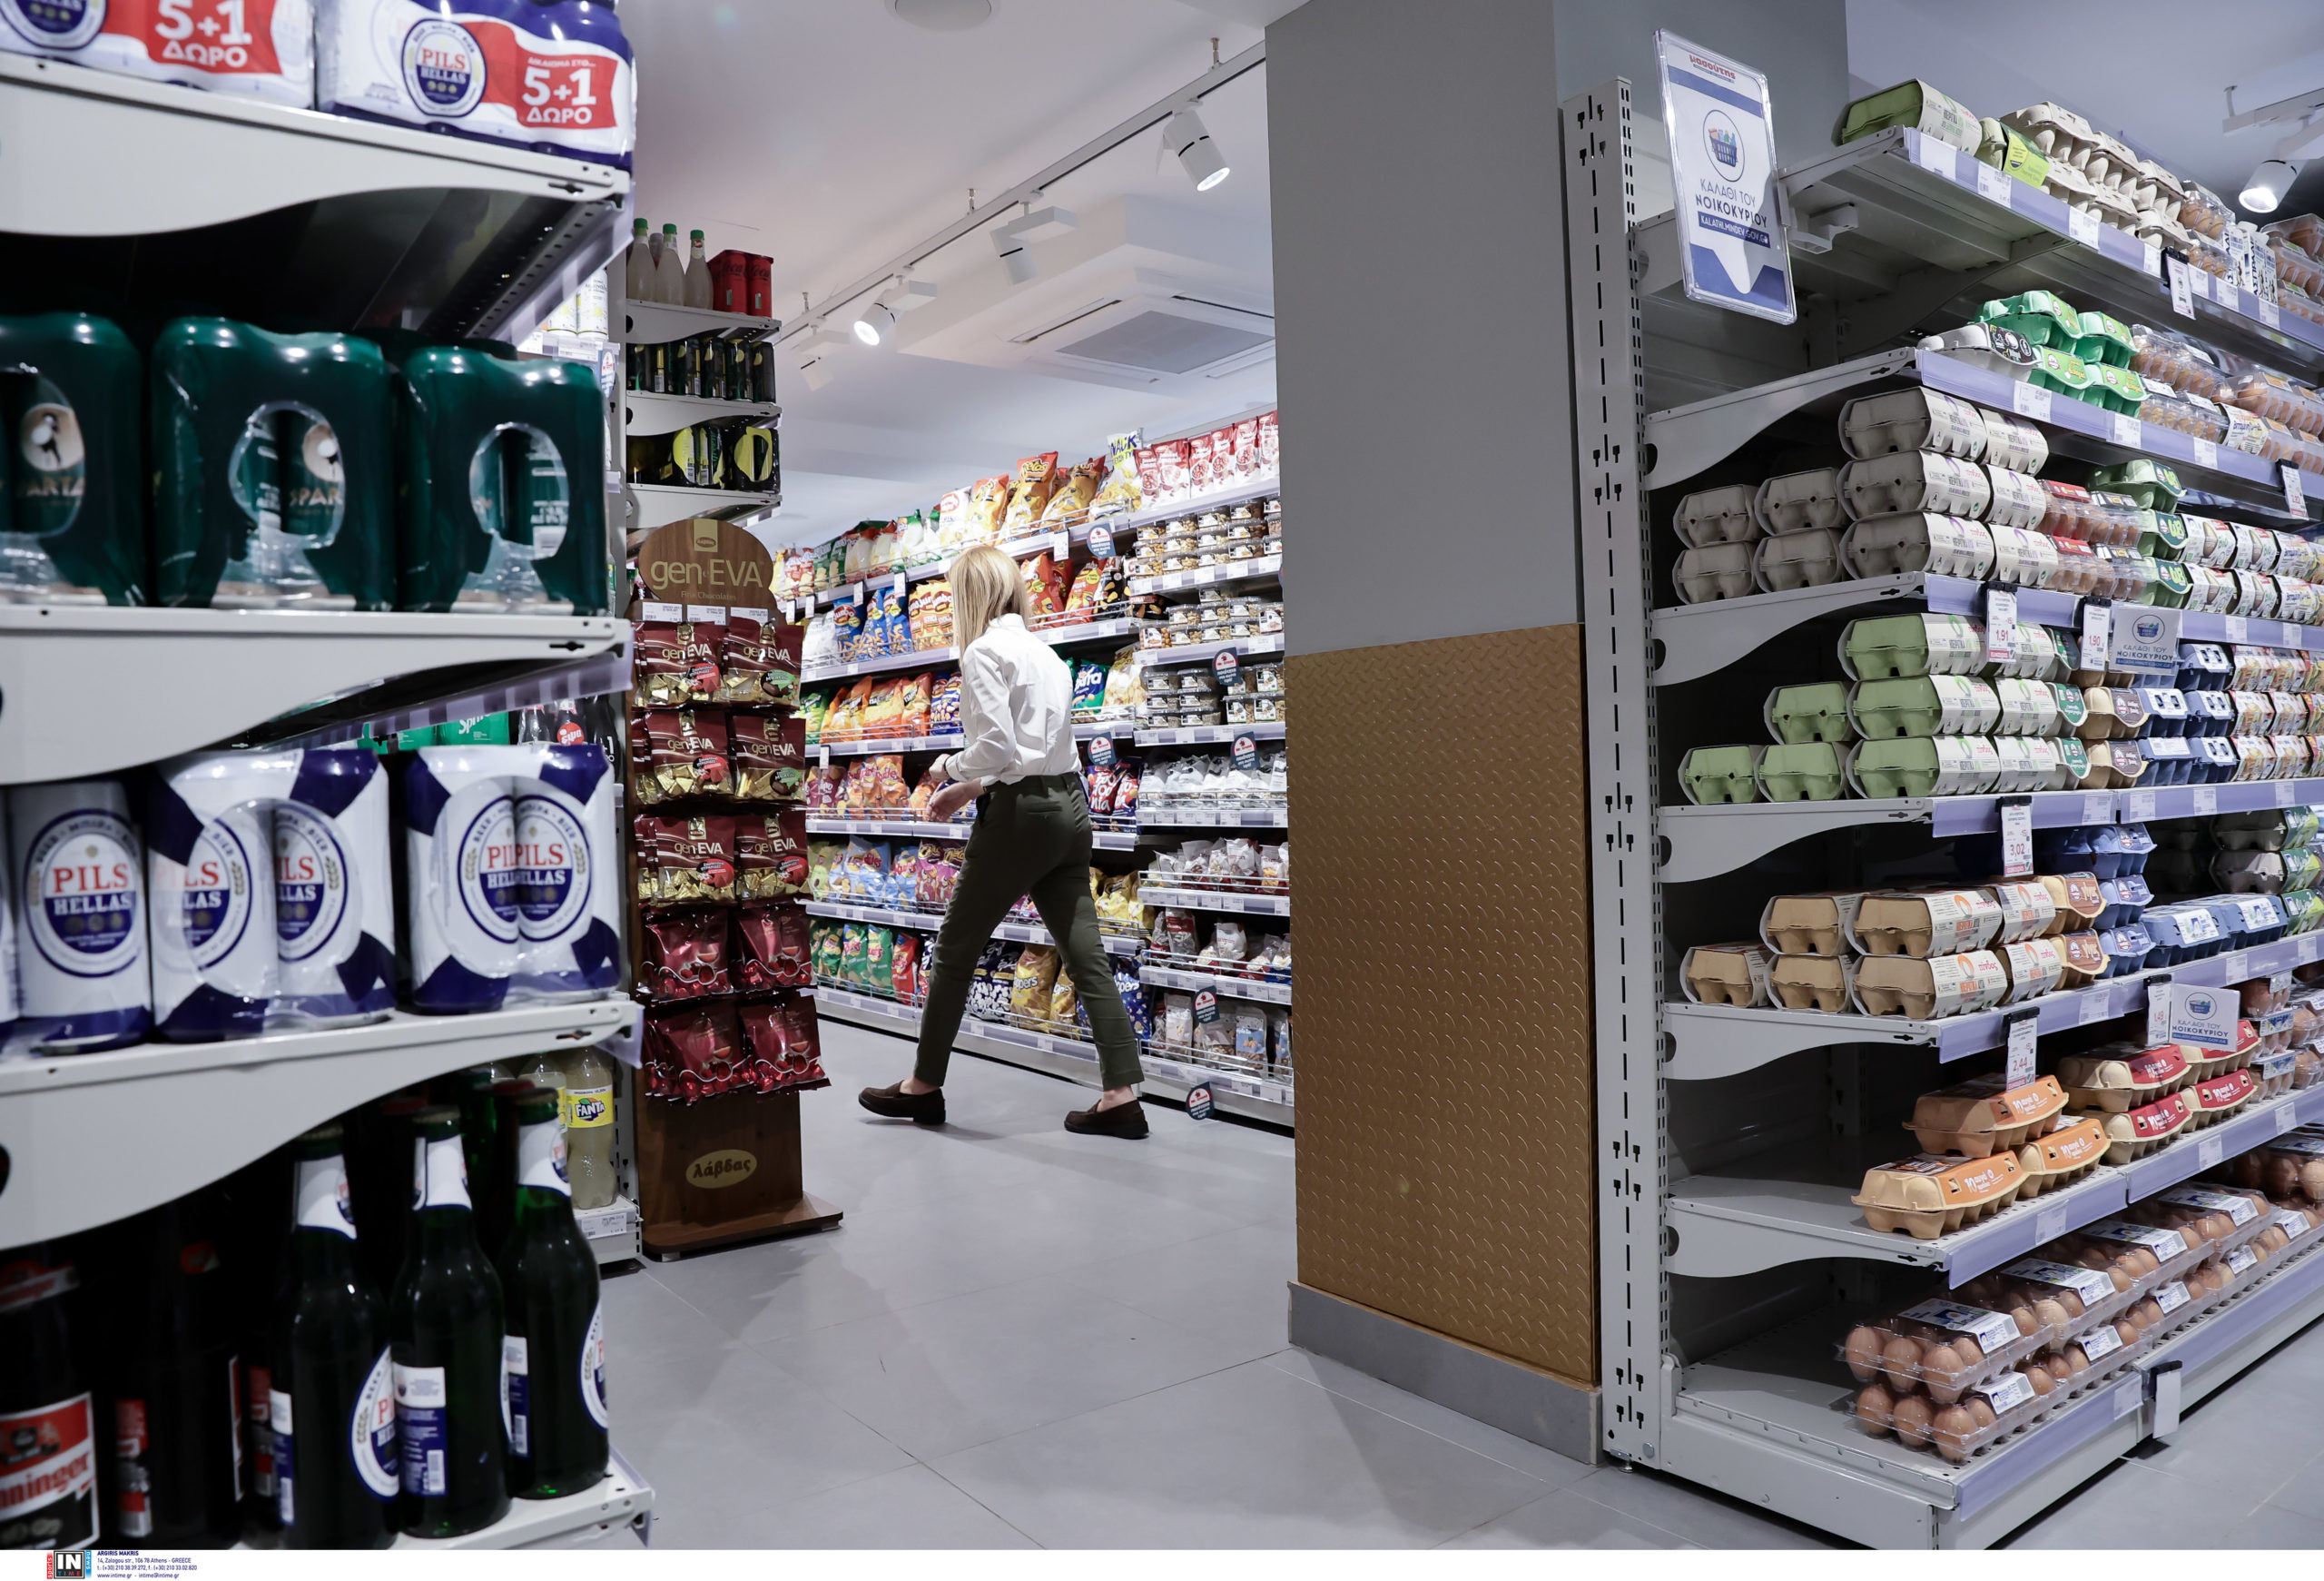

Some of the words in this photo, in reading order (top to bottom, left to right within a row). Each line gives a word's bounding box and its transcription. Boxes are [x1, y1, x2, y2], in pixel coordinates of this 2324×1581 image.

[162, 40, 248, 68] ΔΩΡΟ
[421, 48, 467, 71] PILS
[522, 67, 596, 107] 5+1
[527, 106, 592, 124] ΔΩΡΟ
[1700, 178, 1737, 201] ΚΑΛΑΘΙ
[1739, 191, 1755, 207] ΤΟΥ
[1696, 194, 1767, 228] ΝΟΙΚΟΚΥΡΙΟΥ
[2117, 651, 2173, 661] ΝΟΙΚΟΚΥΡΙΟΥ
[2123, 644, 2151, 652] ΚΑΛΑΘΙ
[515, 843, 564, 866] PILS
[2010, 843, 2025, 856] 3,02
[53, 863, 129, 894] PILS
[53, 890, 133, 915] HELLAS
[2172, 1025, 2229, 1036] ΝΟΙΚΟΚΥΡΙΟΥ
[575, 1101, 606, 1117] FANTA
[693, 1157, 751, 1180] λάβδας
